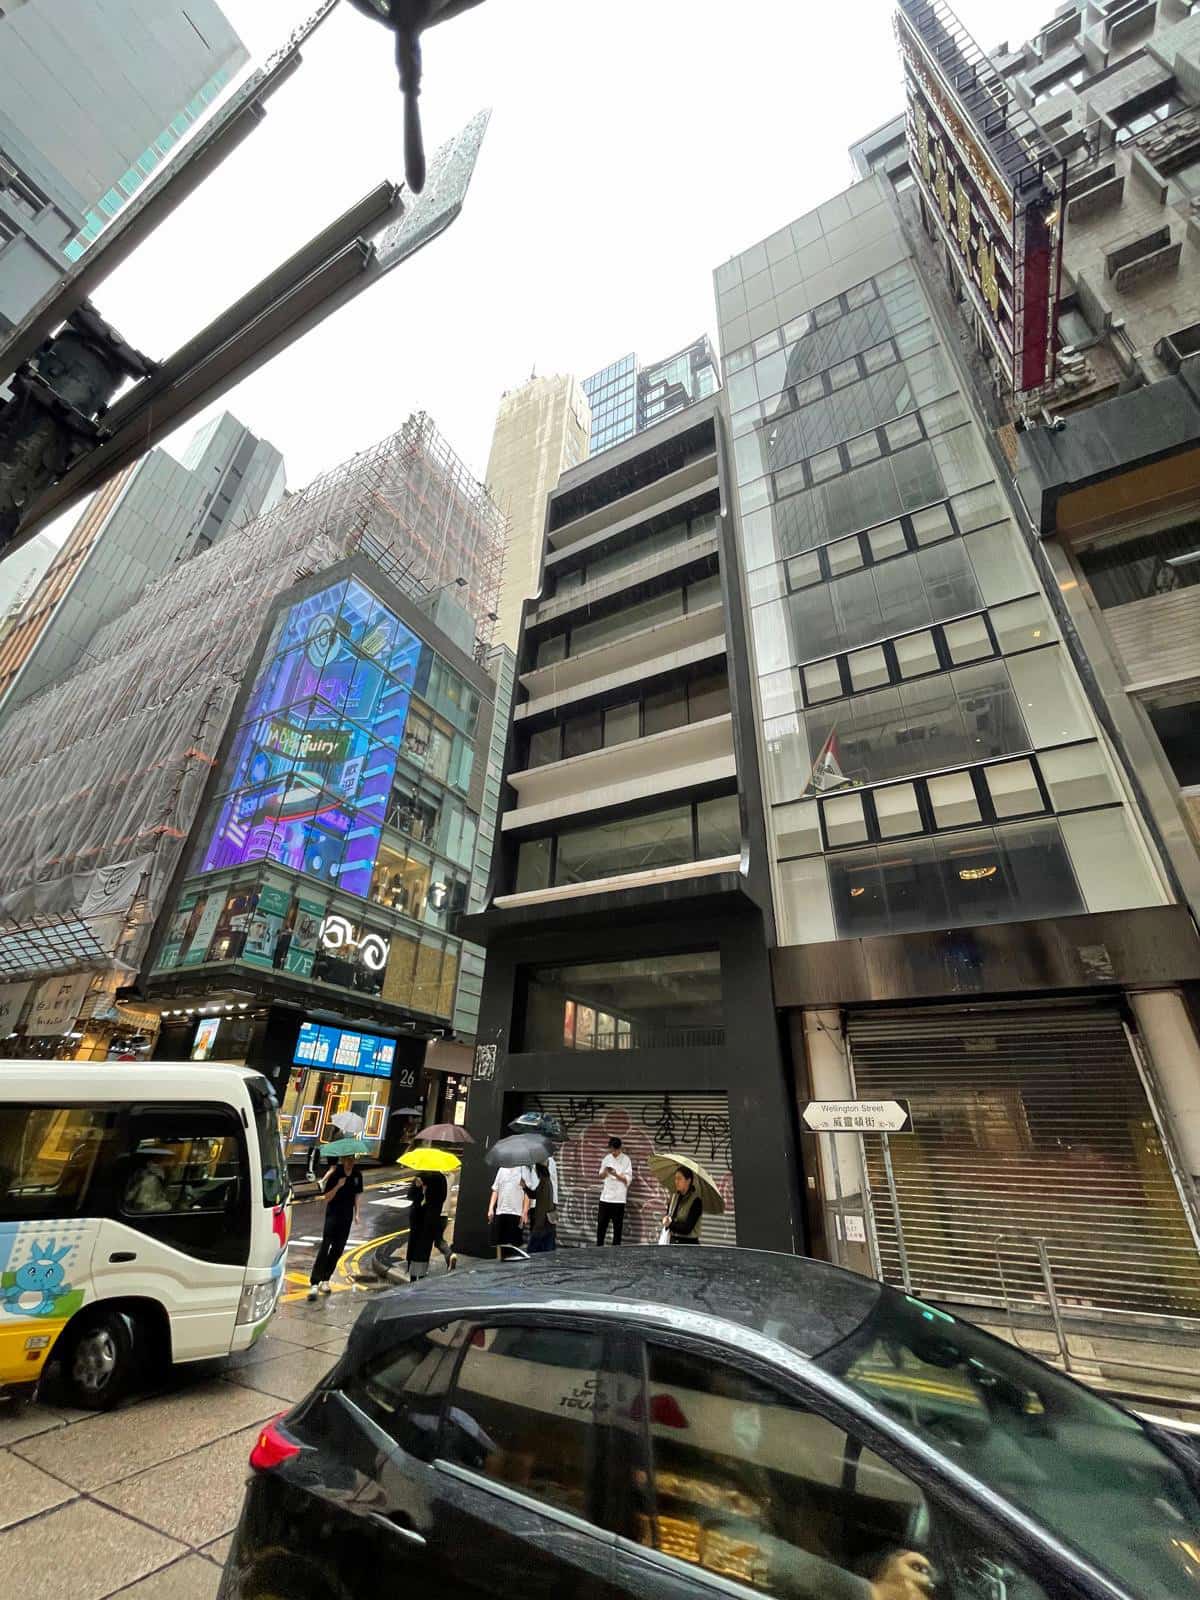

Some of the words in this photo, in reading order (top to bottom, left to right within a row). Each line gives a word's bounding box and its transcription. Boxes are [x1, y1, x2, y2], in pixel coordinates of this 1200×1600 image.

[401, 1069, 415, 1085] 26
[821, 1104, 859, 1113] Wellington
[861, 1104, 884, 1112] Street
